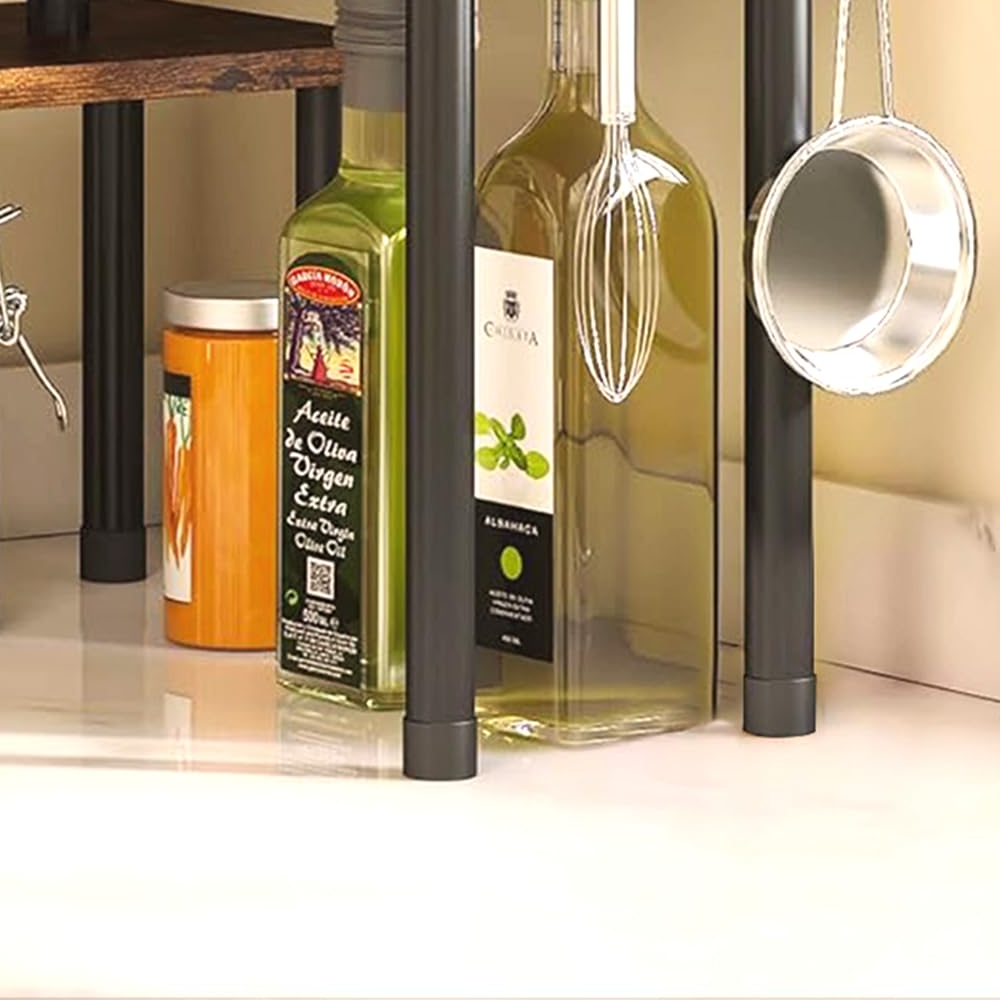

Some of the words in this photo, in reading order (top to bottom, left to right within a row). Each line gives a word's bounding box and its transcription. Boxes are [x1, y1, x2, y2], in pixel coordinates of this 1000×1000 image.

[293, 400, 350, 431] Aceite
[285, 427, 303, 450] de
[307, 430, 357, 464] Oliva
[289, 452, 354, 490] Virgen
[294, 483, 347, 516] Extra
[286, 510, 318, 531] Extra
[319, 517, 355, 543] Virgin
[484, 516, 539, 537] ALBAHACA
[325, 539, 347, 559] Oil
